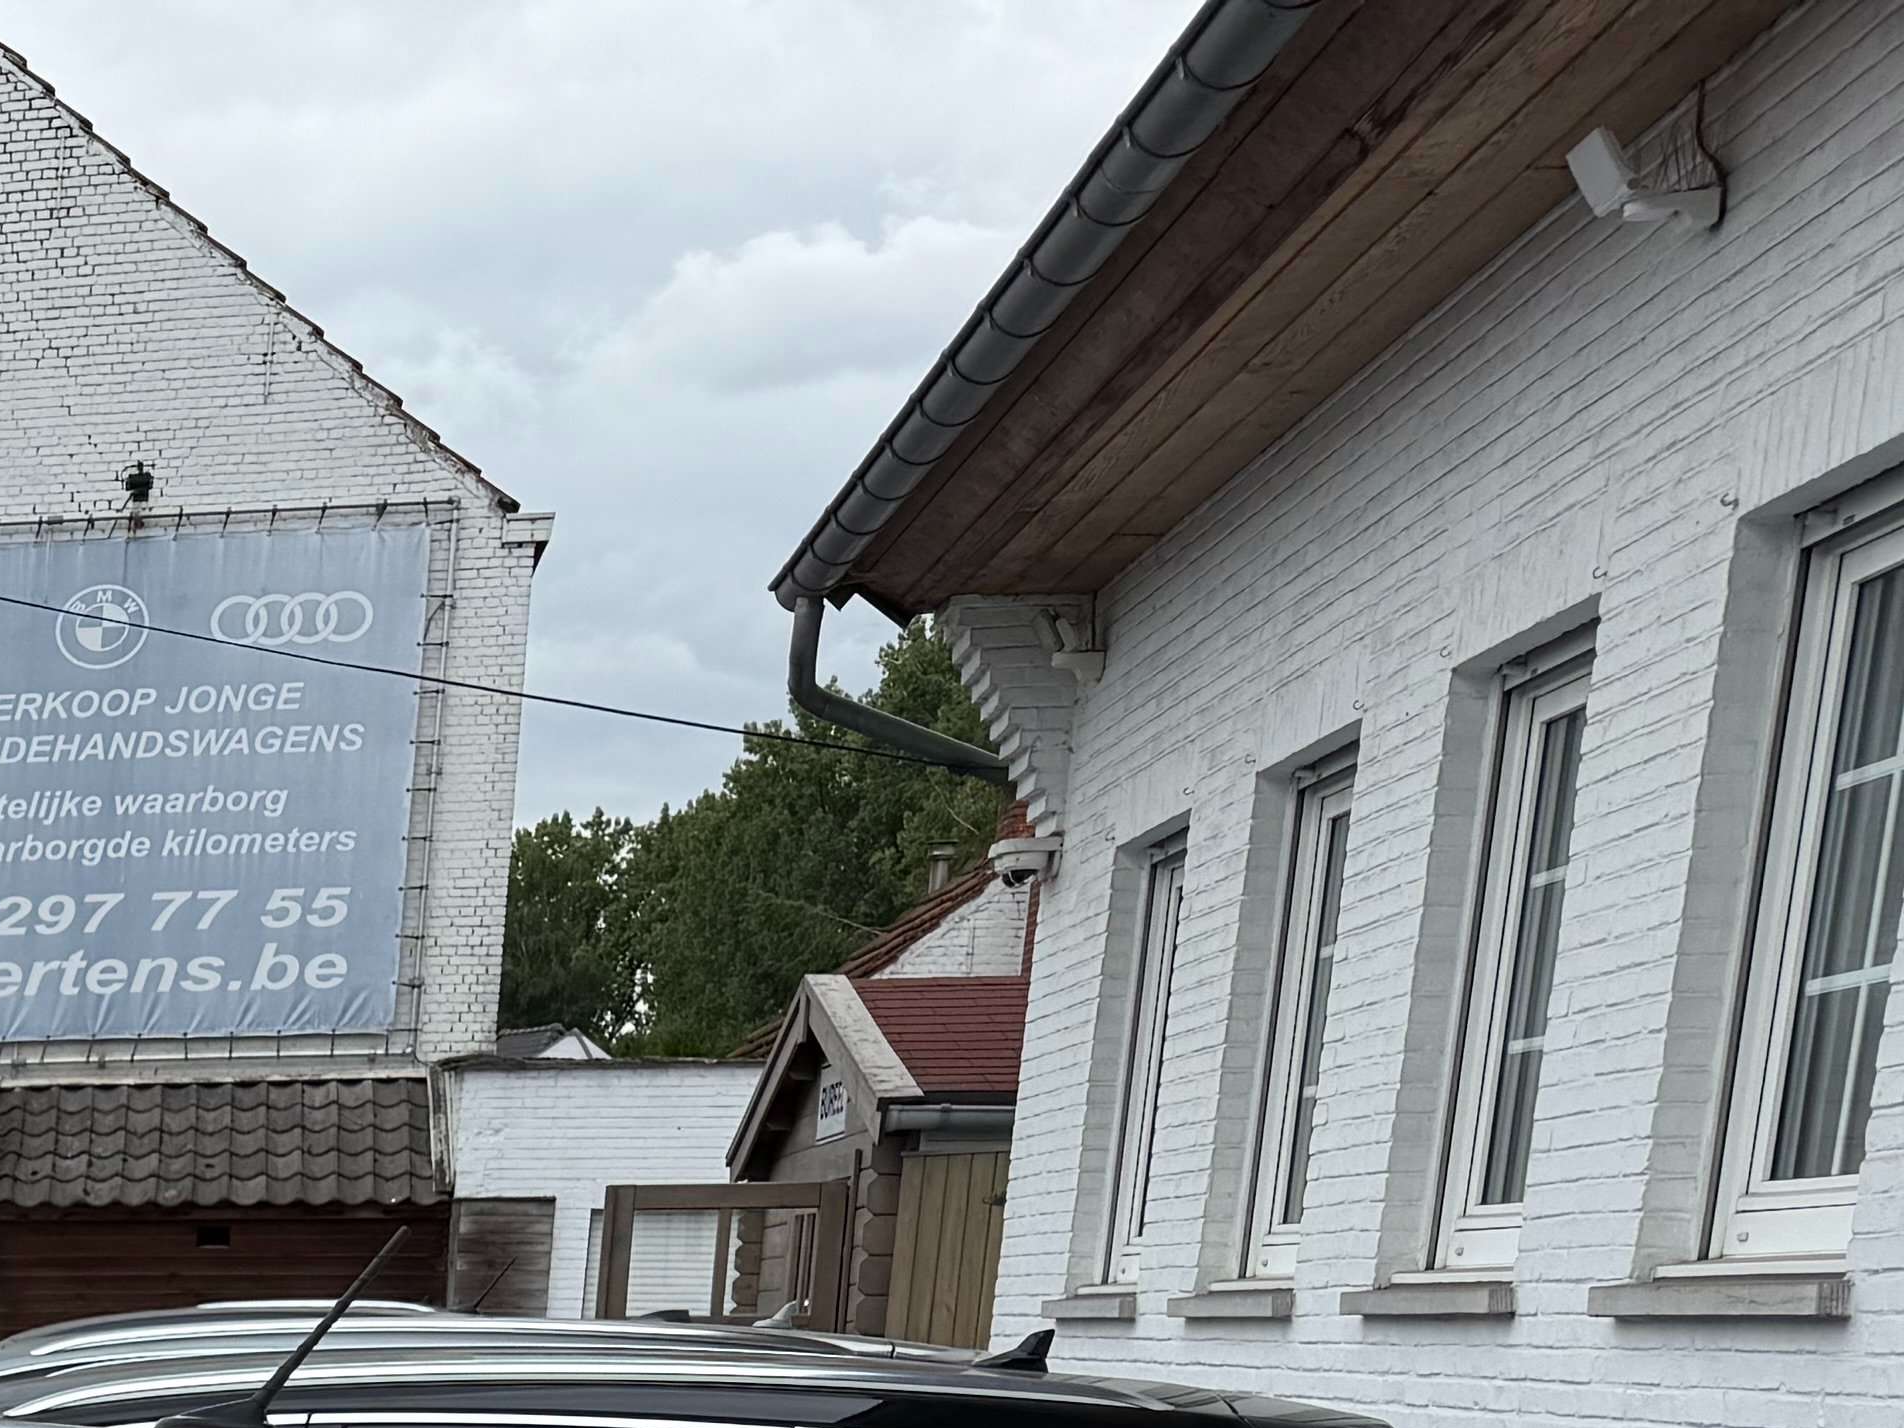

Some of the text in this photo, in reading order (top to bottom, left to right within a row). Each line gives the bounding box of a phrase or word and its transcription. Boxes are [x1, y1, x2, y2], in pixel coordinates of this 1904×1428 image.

[165, 681, 305, 716] JONGE
[114, 785, 289, 817] waarborg
[161, 826, 359, 859] kilometers
[149, 888, 230, 932] 77
[260, 886, 352, 930] 55
